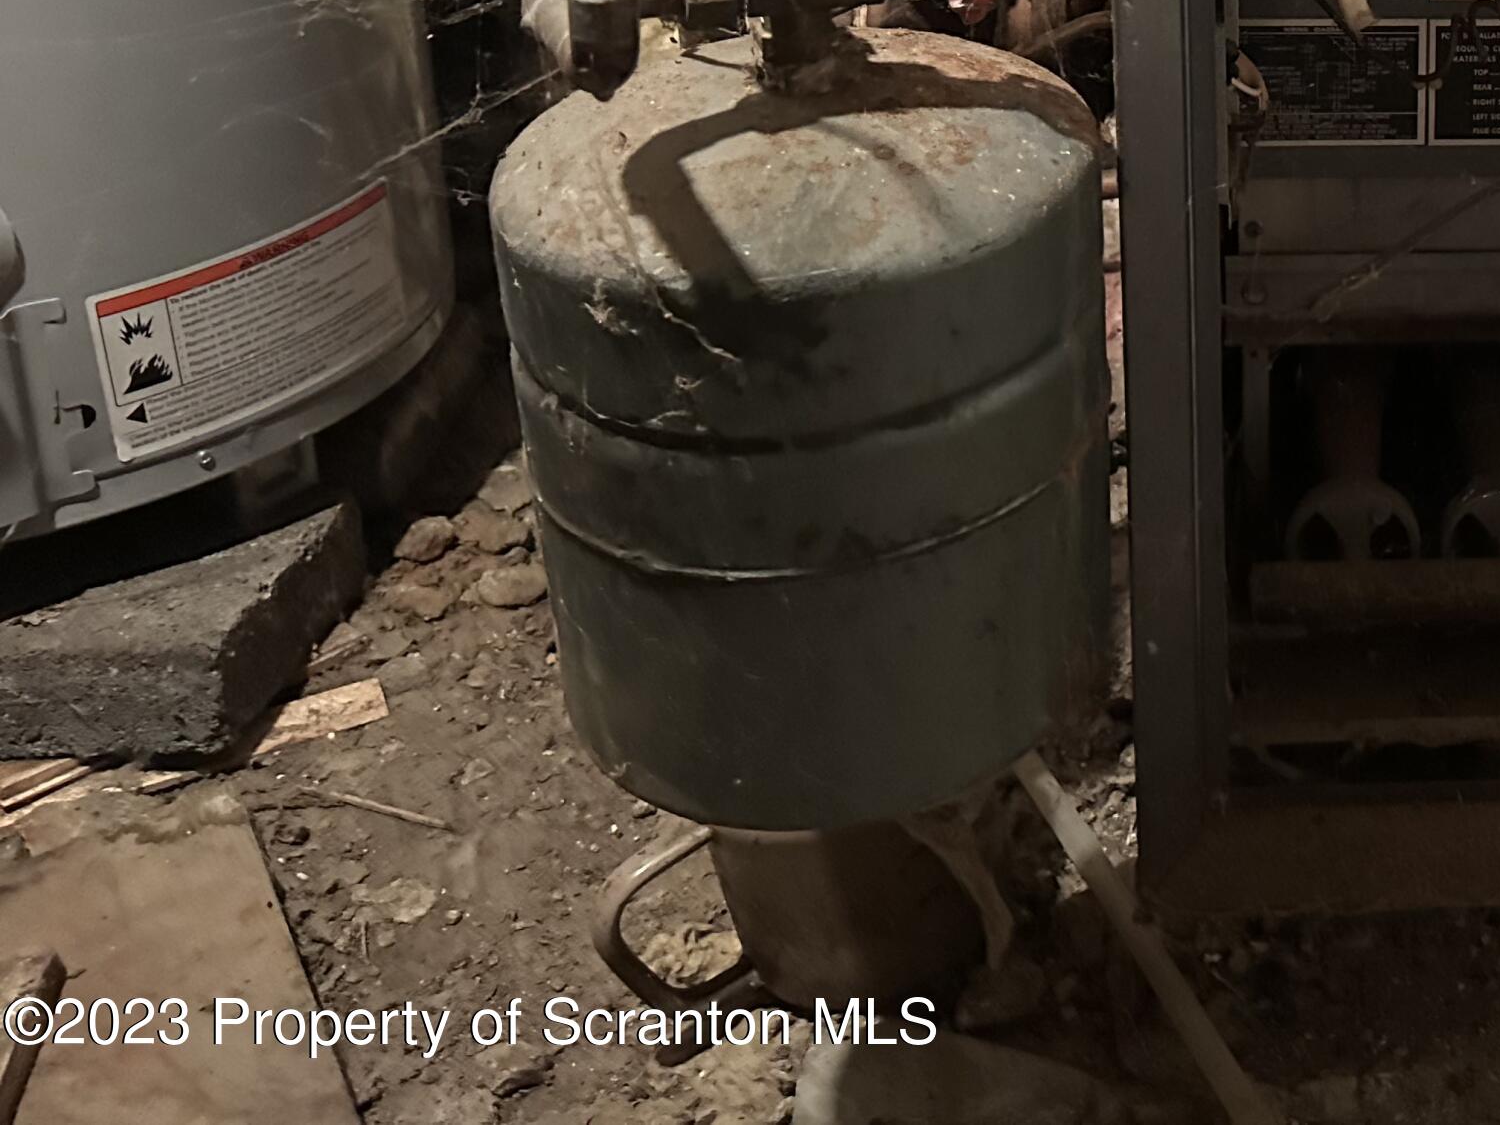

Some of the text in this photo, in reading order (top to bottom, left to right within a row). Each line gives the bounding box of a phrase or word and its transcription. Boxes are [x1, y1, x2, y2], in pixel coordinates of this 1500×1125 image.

[1474, 68, 1489, 76] TOP
[1473, 83, 1492, 91] REAR
[1472, 98, 1496, 106] RIGHT
[1472, 113, 1488, 121] LEFT
